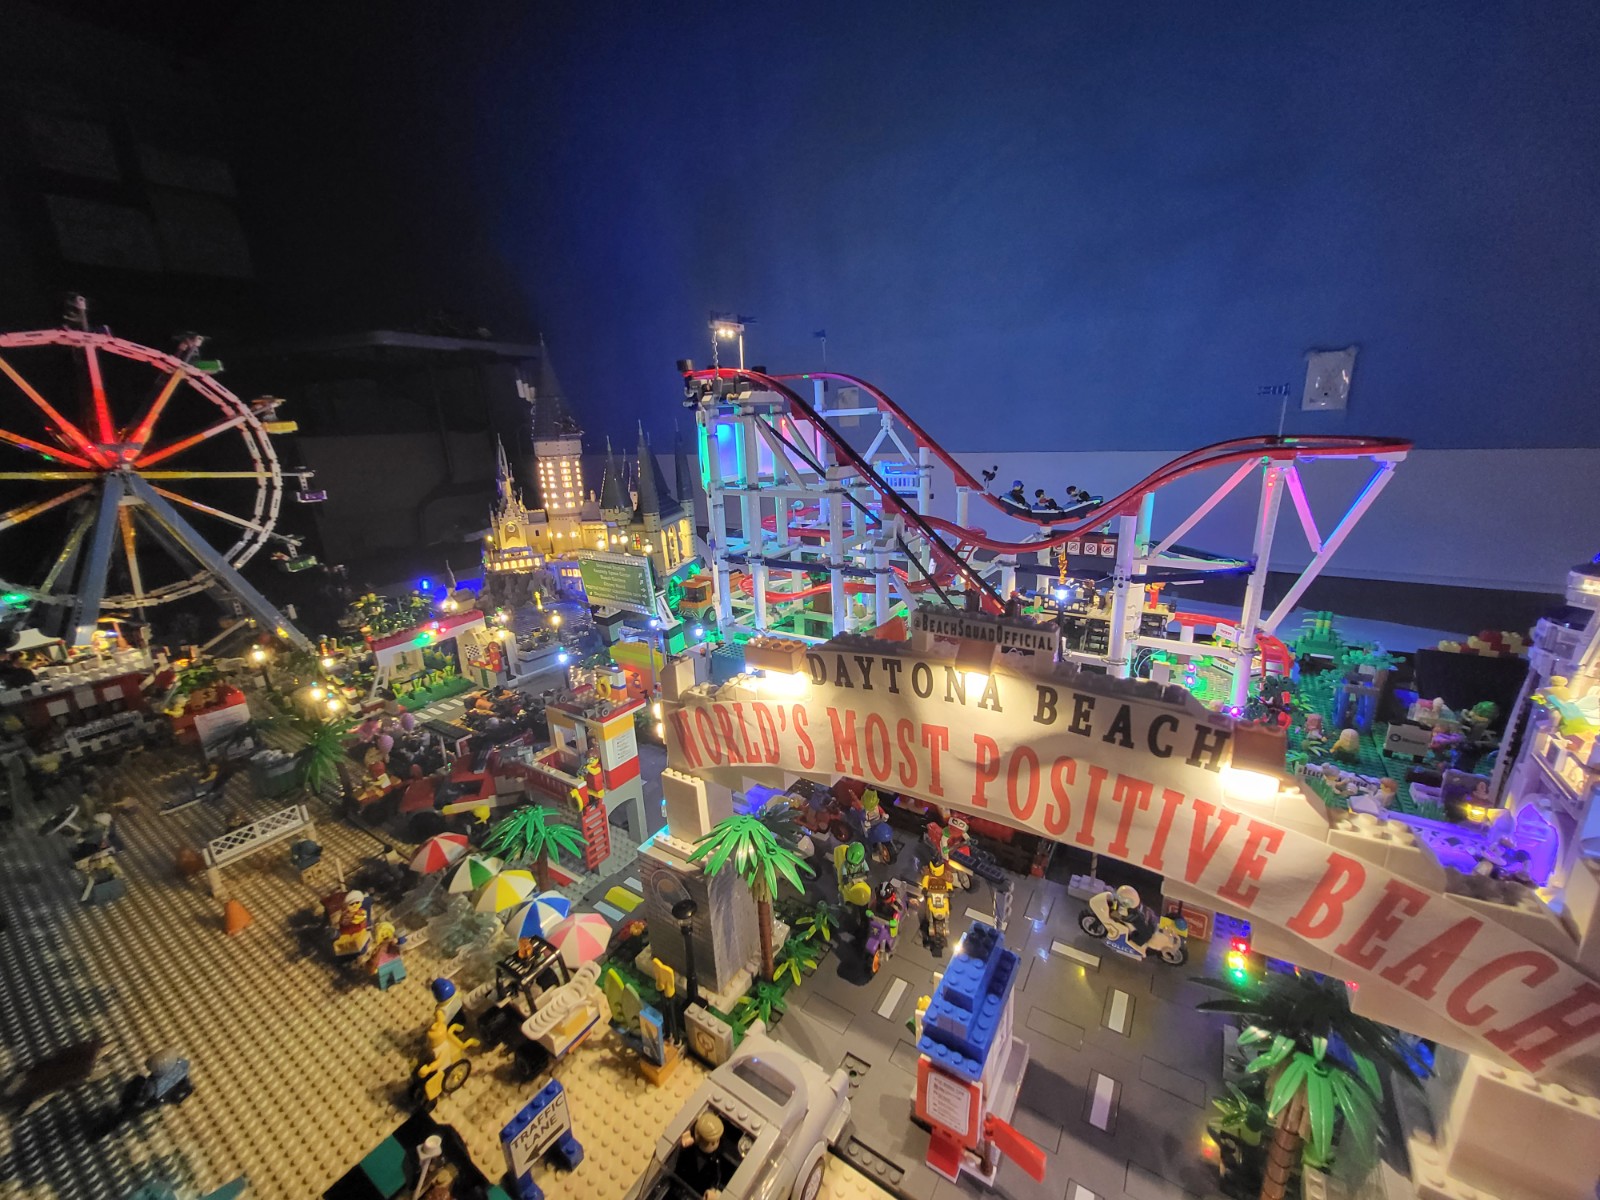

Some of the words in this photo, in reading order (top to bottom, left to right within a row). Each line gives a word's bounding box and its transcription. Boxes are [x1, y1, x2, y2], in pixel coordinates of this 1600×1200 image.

[807, 653, 1004, 713] DAYTONA
[1033, 684, 1232, 773] BEACH
[669, 703, 816, 771] WORLD'S
[827, 707, 949, 797] MOST
[971, 733, 1286, 910] POSITIVE
[1286, 851, 1600, 1074] BEACH
[511, 1094, 564, 1149] TRAFFIC
[524, 1114, 557, 1152] LANE
